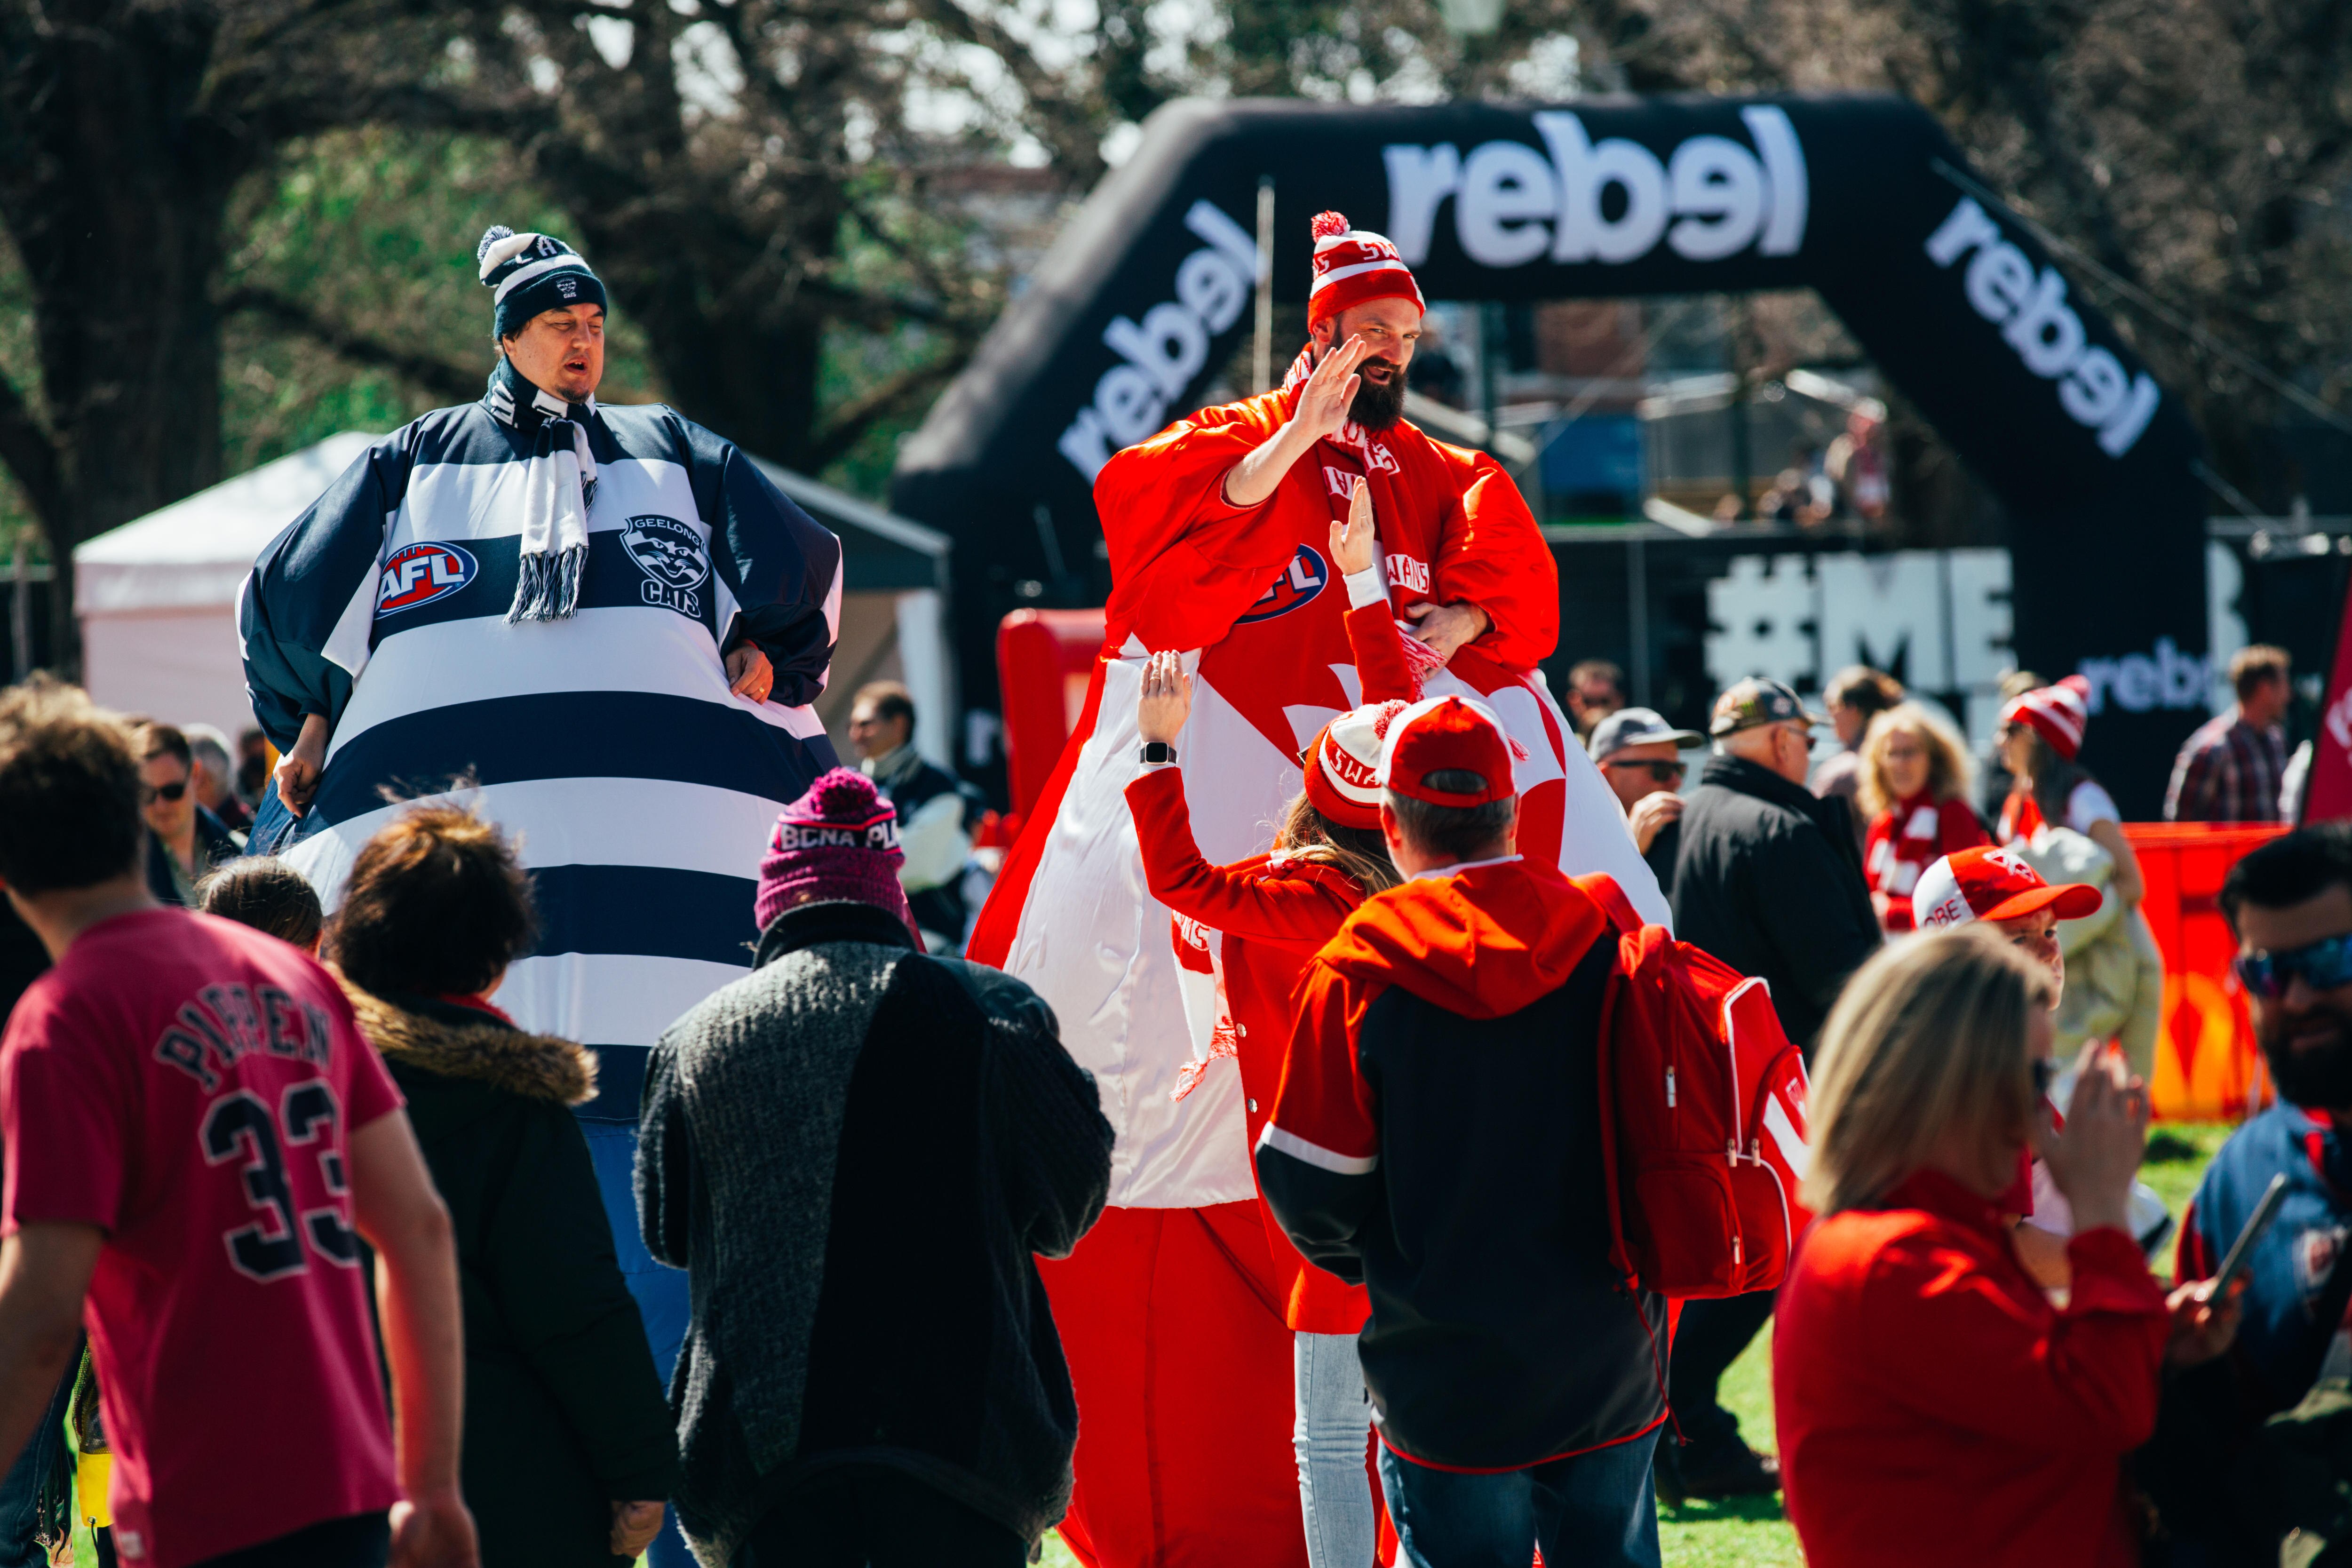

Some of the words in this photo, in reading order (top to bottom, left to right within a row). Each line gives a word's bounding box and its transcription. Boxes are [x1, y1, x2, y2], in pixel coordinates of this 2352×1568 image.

[1383, 104, 1809, 268] rebel
[1057, 198, 1269, 488] rebel
[1924, 195, 2161, 459] rebel
[635, 518, 700, 547] GEELONG
[375, 553, 465, 612] AFL
[641, 579, 701, 618] CATS
[2076, 636, 2213, 716] reb
[781, 824, 856, 851] BCNA
[199, 1076, 361, 1284] 33
